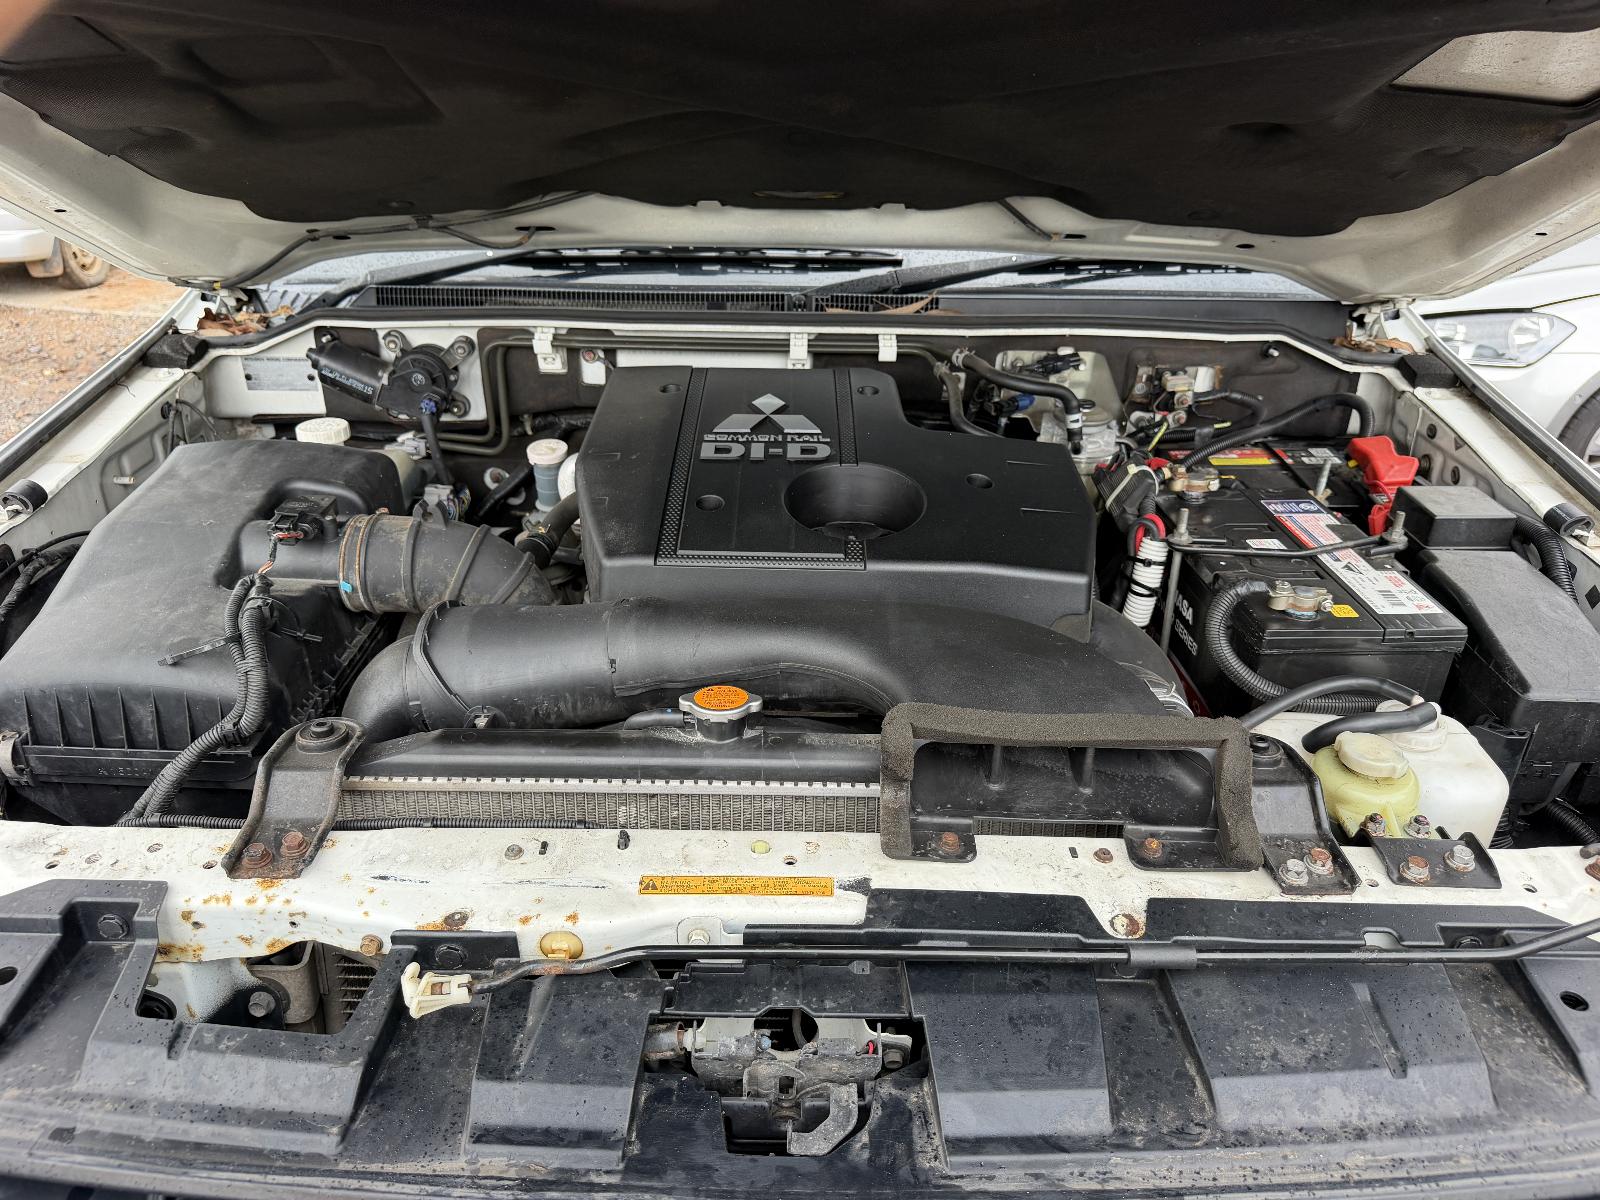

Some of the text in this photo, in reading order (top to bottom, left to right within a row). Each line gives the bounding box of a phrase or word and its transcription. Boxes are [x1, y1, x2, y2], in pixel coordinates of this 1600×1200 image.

[703, 434, 831, 442] COMMON RAIL
[700, 442, 832, 461] DI-D
